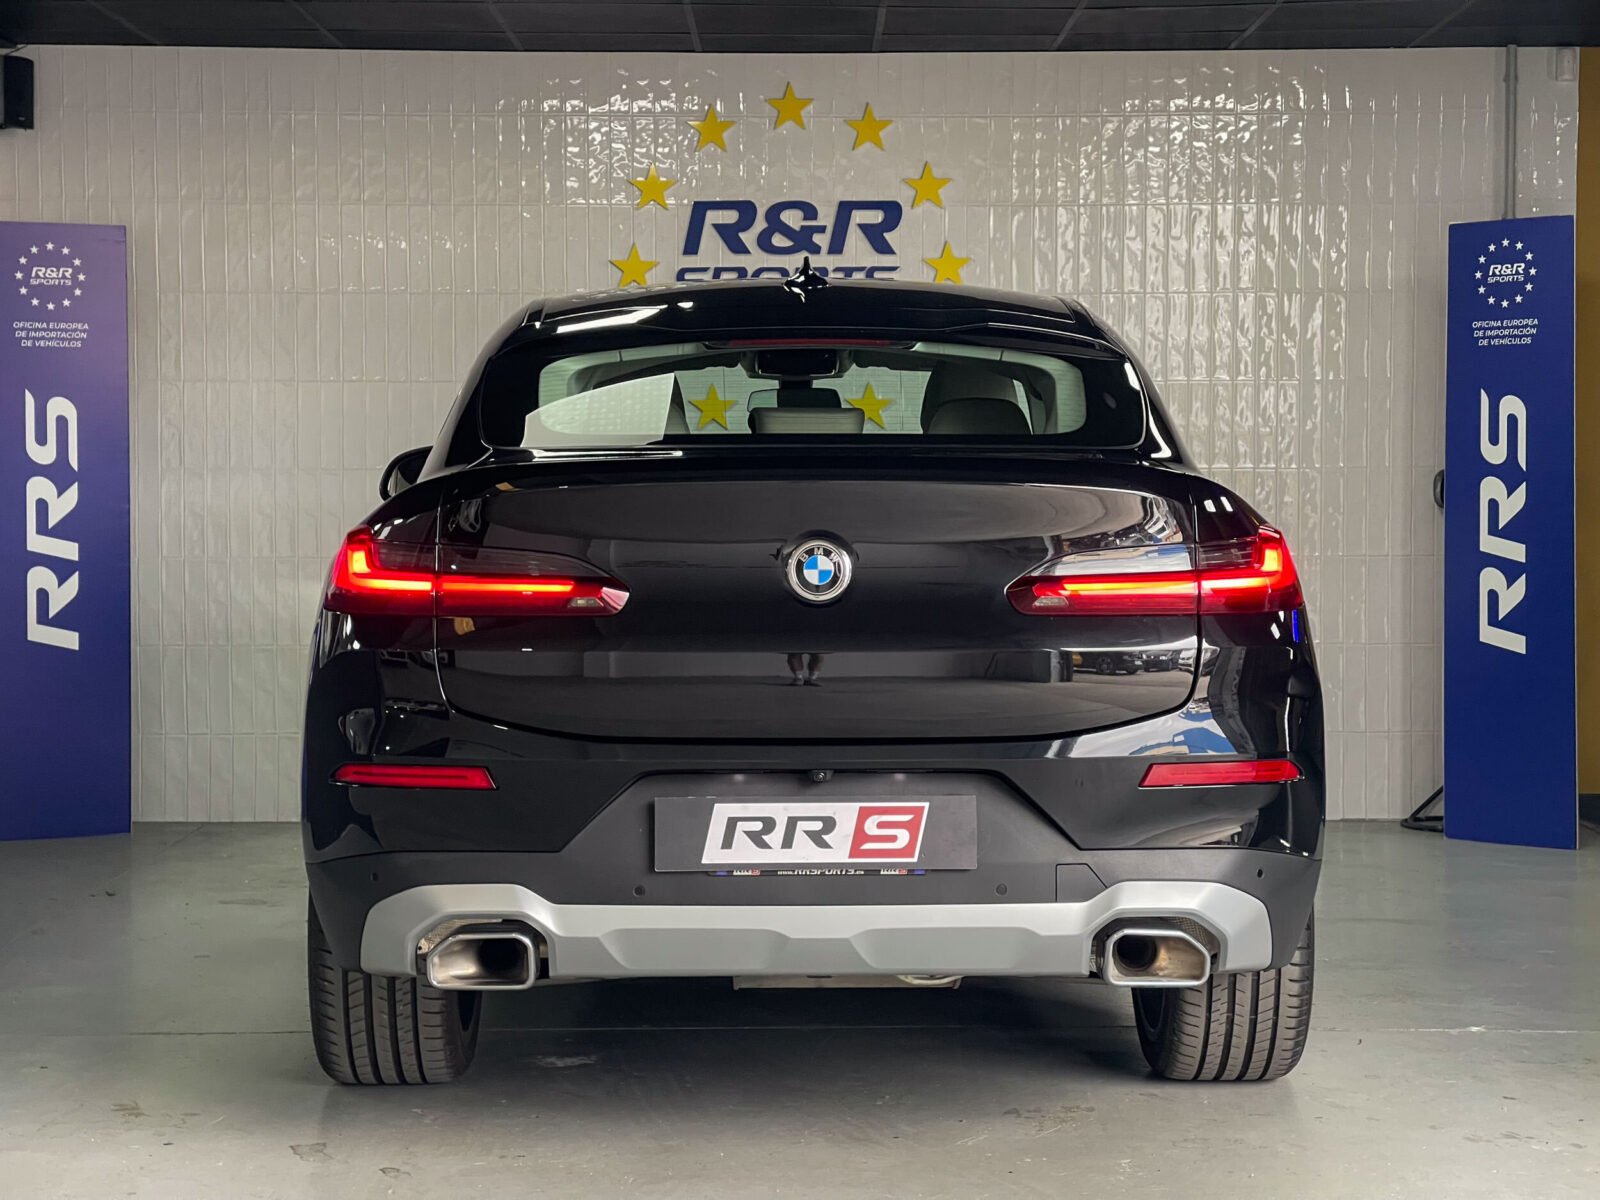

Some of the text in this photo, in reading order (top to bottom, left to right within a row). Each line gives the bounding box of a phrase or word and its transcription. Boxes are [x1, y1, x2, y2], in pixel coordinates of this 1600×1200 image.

[682, 200, 903, 256] R&R
[31, 267, 73, 278] R&R
[1489, 263, 1526, 276] R&R
[29, 278, 72, 286] SPORTS
[1487, 275, 1525, 283] SPORTS
[13, 321, 89, 330] OFICINA EUROPEA
[1472, 318, 1538, 328] OFICINA EUROPEA
[15, 330, 87, 339] DE IMPORTACIÓN
[1485, 327, 1537, 337] IMPORTACIÓN
[35, 339, 82, 348] VEHÍCULOS
[1490, 336, 1532, 346] VEHÍCULOS
[25, 388, 79, 651] RRS
[1479, 387, 1526, 655] RRS
[799, 547, 840, 563] BMW
[720, 814, 916, 850] RRS
